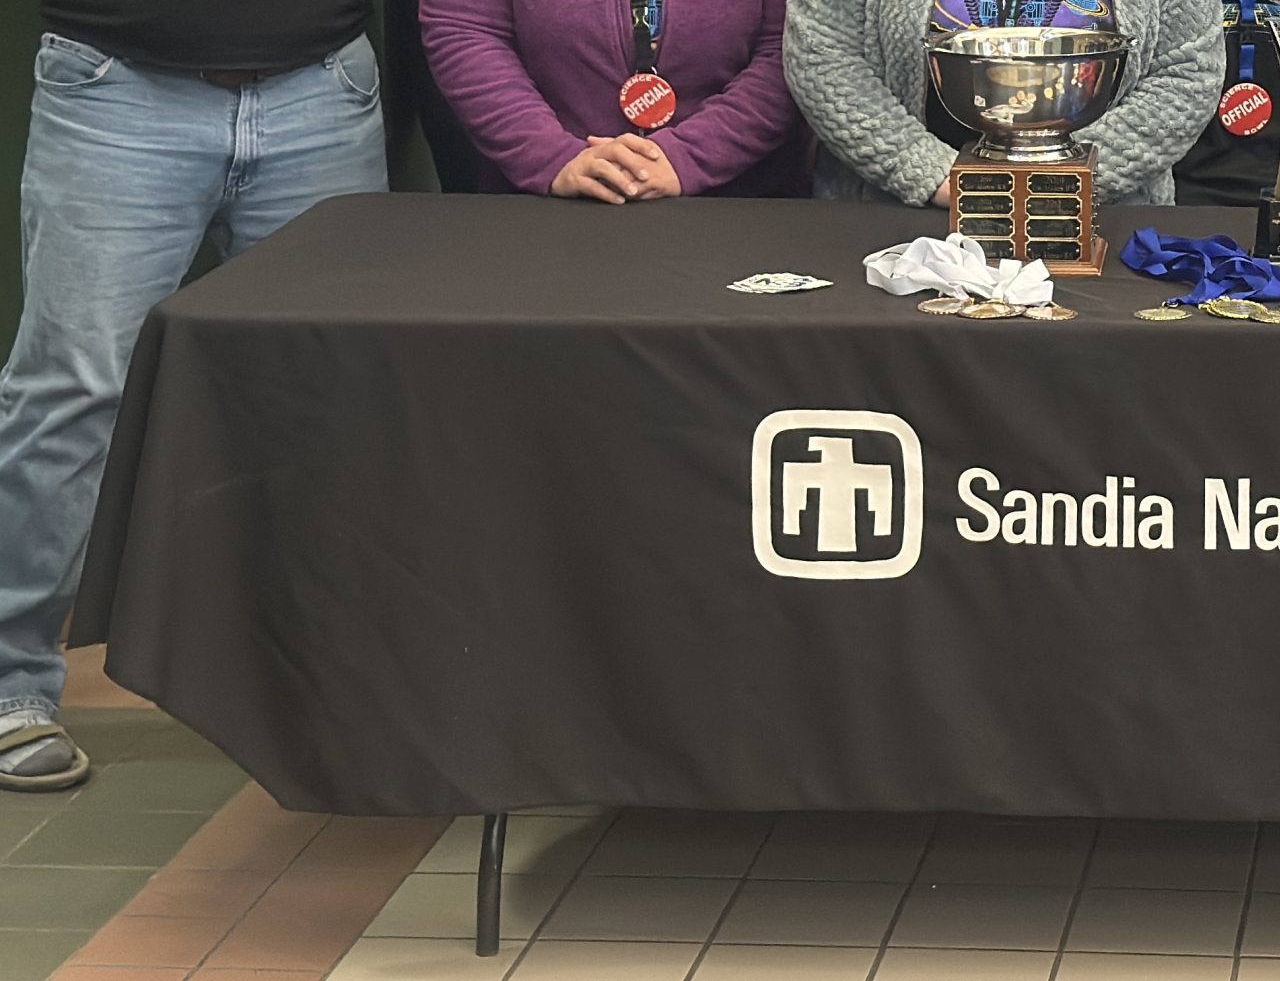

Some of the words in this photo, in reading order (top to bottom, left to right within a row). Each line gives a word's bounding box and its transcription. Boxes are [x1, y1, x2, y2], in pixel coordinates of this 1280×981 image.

[620, 75, 652, 102] SCIENCE
[623, 82, 671, 121] OFFICIAL
[1219, 82, 1254, 108] SCIENCE
[651, 111, 675, 128] BOWL
[1221, 91, 1269, 127] OFFICIAL
[1243, 119, 1269, 136] BOWL
[956, 468, 1174, 550] Sandia
